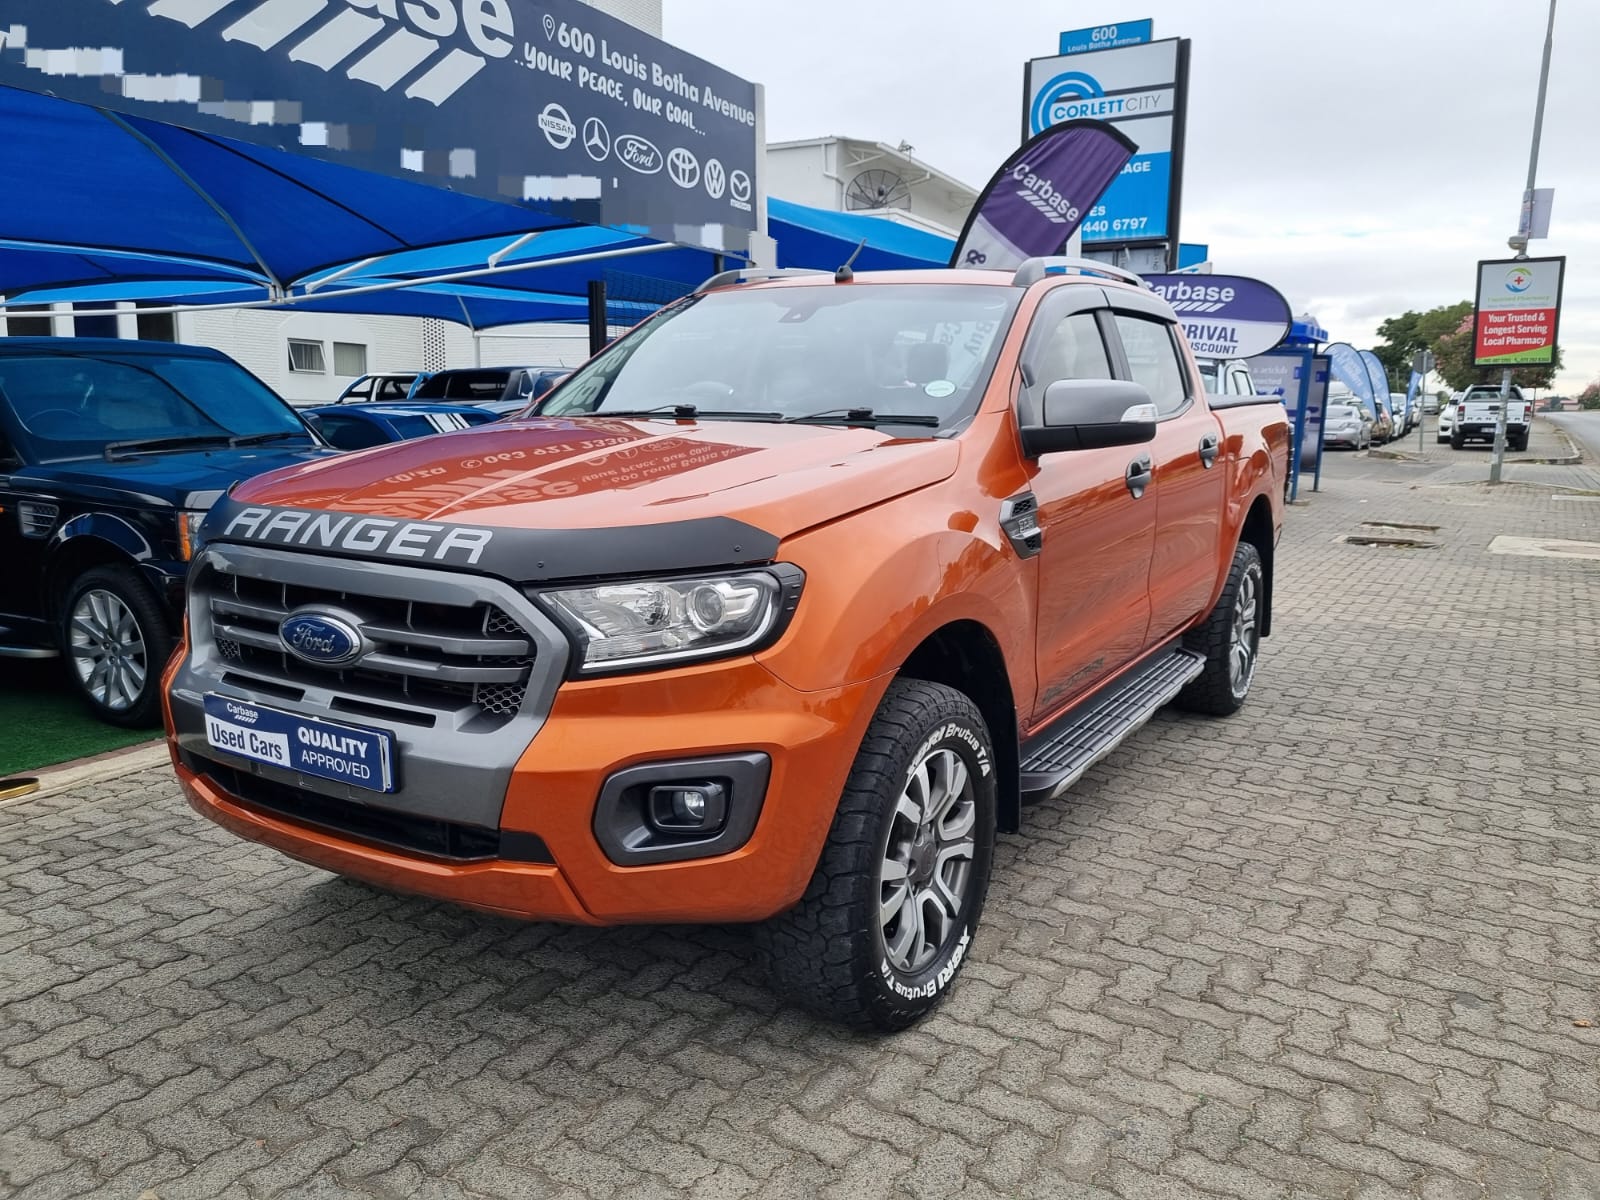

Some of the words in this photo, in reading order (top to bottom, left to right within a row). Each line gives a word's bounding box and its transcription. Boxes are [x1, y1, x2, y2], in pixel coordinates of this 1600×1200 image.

[1091, 26, 1117, 42] 600
[558, 22, 596, 58] 600
[601, 40, 647, 81] Louis
[652, 62, 699, 103] Botha
[702, 86, 756, 127] Avenue
[632, 87, 662, 117] OUR
[540, 118, 575, 136] NISSAN
[623, 140, 654, 168] Ford
[1013, 163, 1079, 222] Carbase
[1083, 220, 1108, 232] 440
[1113, 217, 1147, 231] 6797
[1484, 325, 1515, 336] Longest
[1517, 324, 1548, 335] Serving
[1488, 313, 1505, 323] Your
[1507, 312, 1536, 323] Trusted
[1538, 312, 1545, 321] &
[1181, 324, 1239, 343] RIVAL
[1483, 337, 1504, 346] Local
[1506, 336, 1546, 346] Pharmacy
[223, 507, 494, 565] RANGER
[292, 623, 335, 655] Ford
[226, 702, 259, 718] Carbase
[211, 722, 246, 750] Used
[249, 732, 283, 760] Cars
[297, 726, 368, 758] QUALITY
[945, 723, 980, 751] Brutus
[976, 746, 991, 777] T/A
[301, 750, 370, 779] APPROVED
[895, 977, 936, 1002] Brutus
